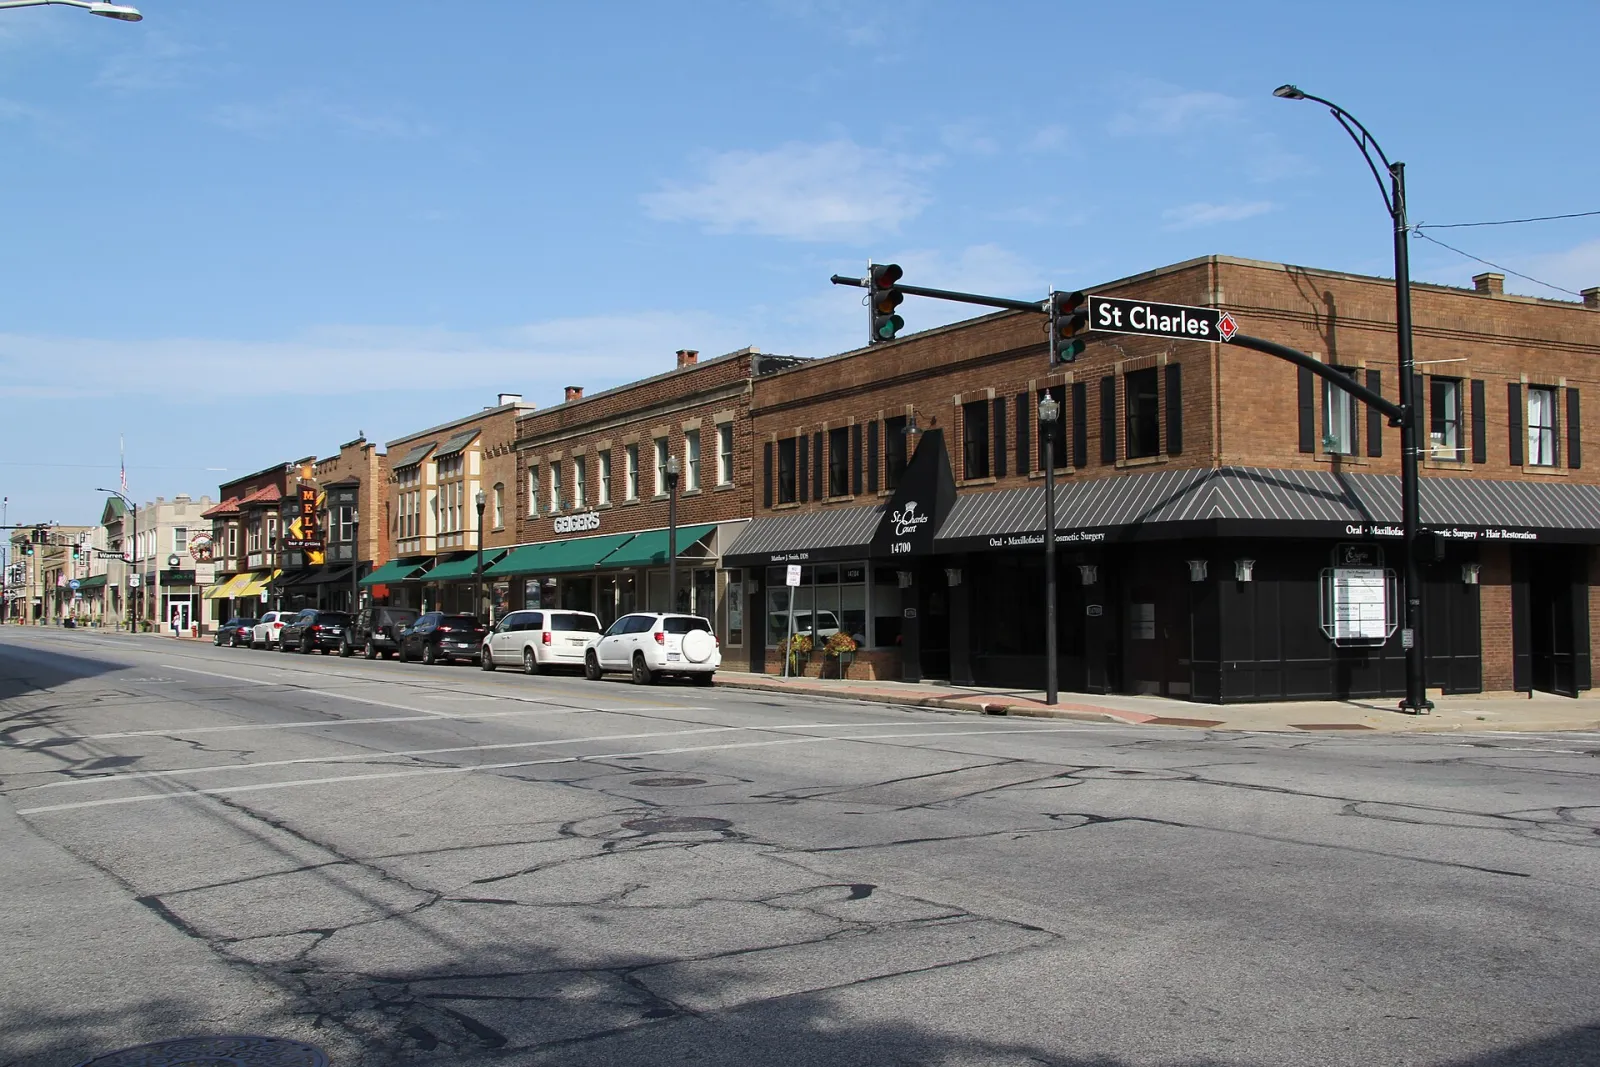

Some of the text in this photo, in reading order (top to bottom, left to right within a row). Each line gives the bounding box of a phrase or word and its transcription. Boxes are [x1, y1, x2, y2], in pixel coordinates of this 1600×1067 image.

[1099, 303, 1210, 336] St Charles
[302, 490, 314, 540] MELT
[554, 511, 600, 533] GEIGER'S
[901, 509, 929, 526] Charles
[896, 520, 918, 536] Court
[1345, 524, 1363, 535] Oral
[1369, 525, 1404, 536] Maxillofac
[1452, 528, 1477, 540] Surgery
[1485, 529, 1501, 539] Hair
[1501, 529, 1537, 540] Restoration
[989, 537, 1003, 547] Oral
[1008, 534, 1045, 546] Maxillofacial
[1080, 531, 1105, 542] Surgery
[891, 541, 911, 554] 14700
